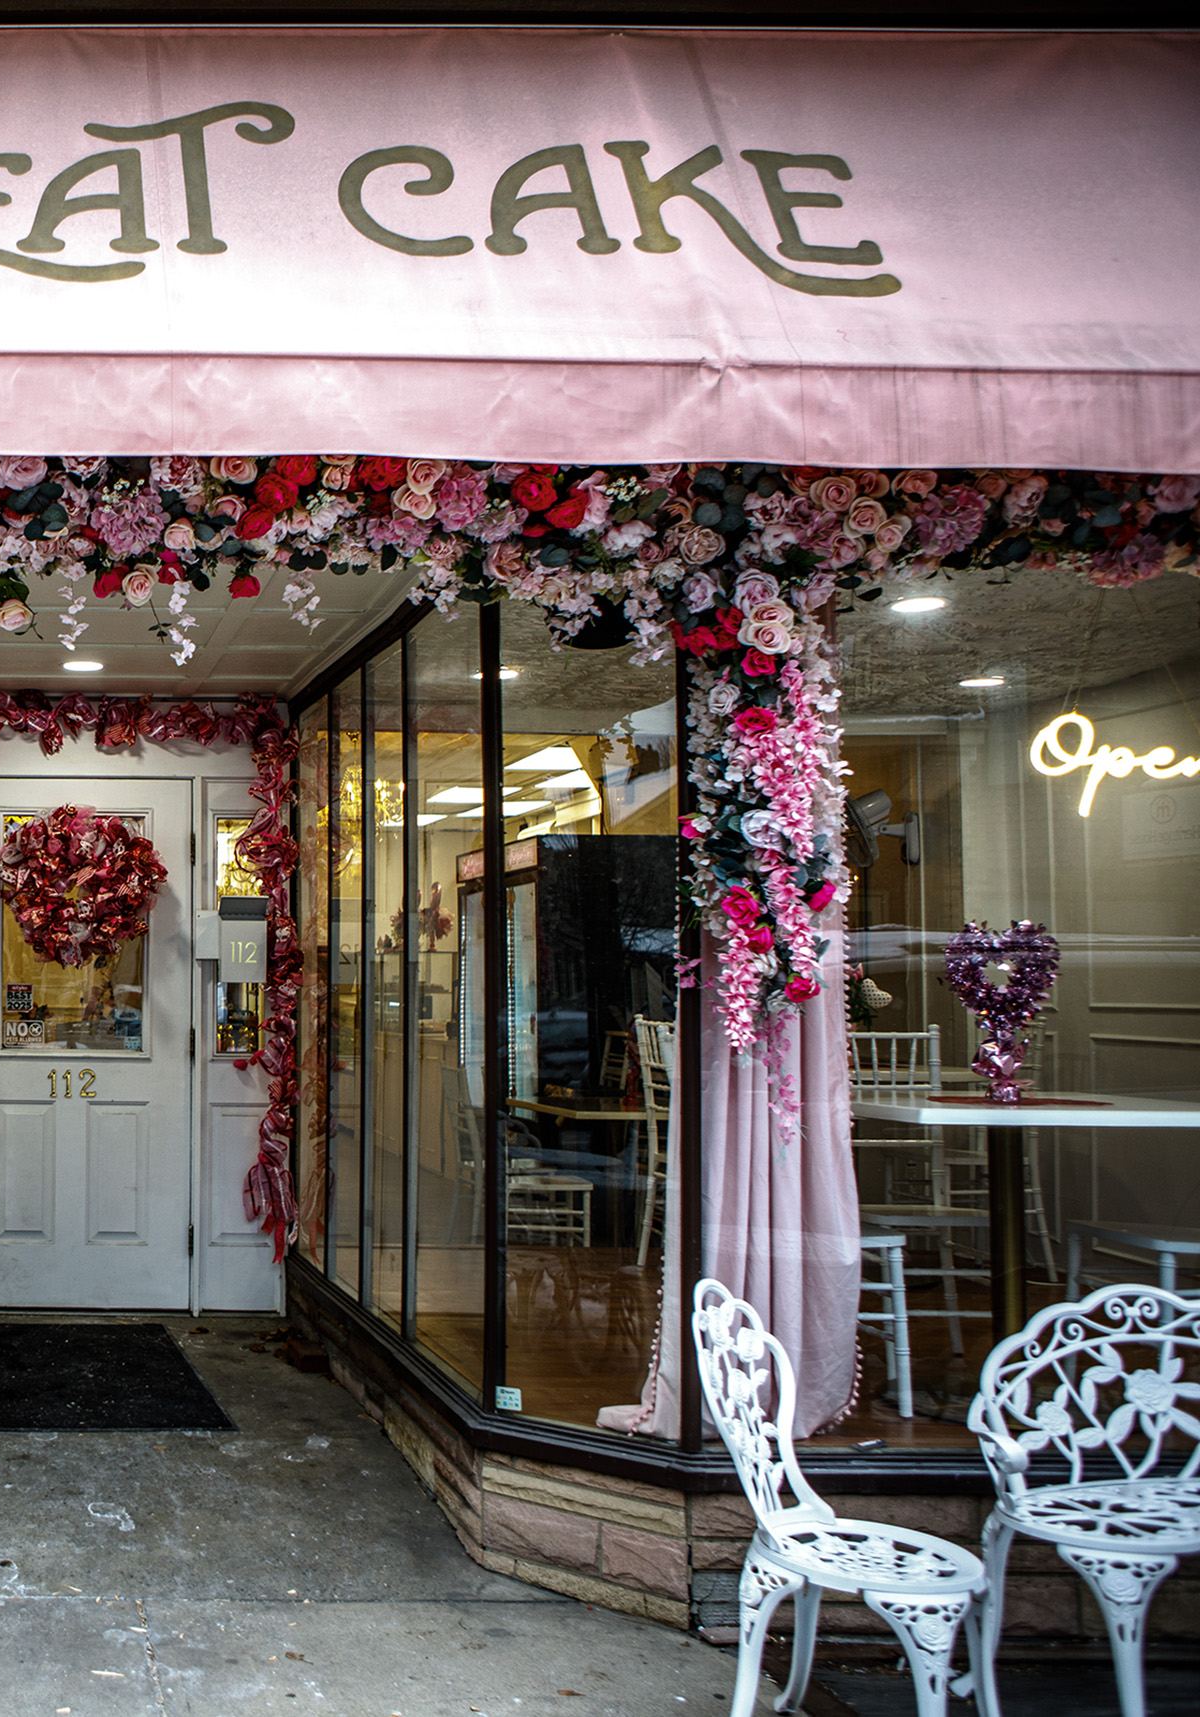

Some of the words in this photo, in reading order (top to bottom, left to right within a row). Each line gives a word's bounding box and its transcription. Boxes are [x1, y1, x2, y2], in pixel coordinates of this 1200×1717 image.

[338, 140, 902, 297] CAKE
[230, 941, 257, 964] 112
[7, 991, 32, 999] BEST
[7, 1001, 32, 1010] 2025
[6, 1022, 28, 1036] NO
[47, 1068, 97, 1098] 112
